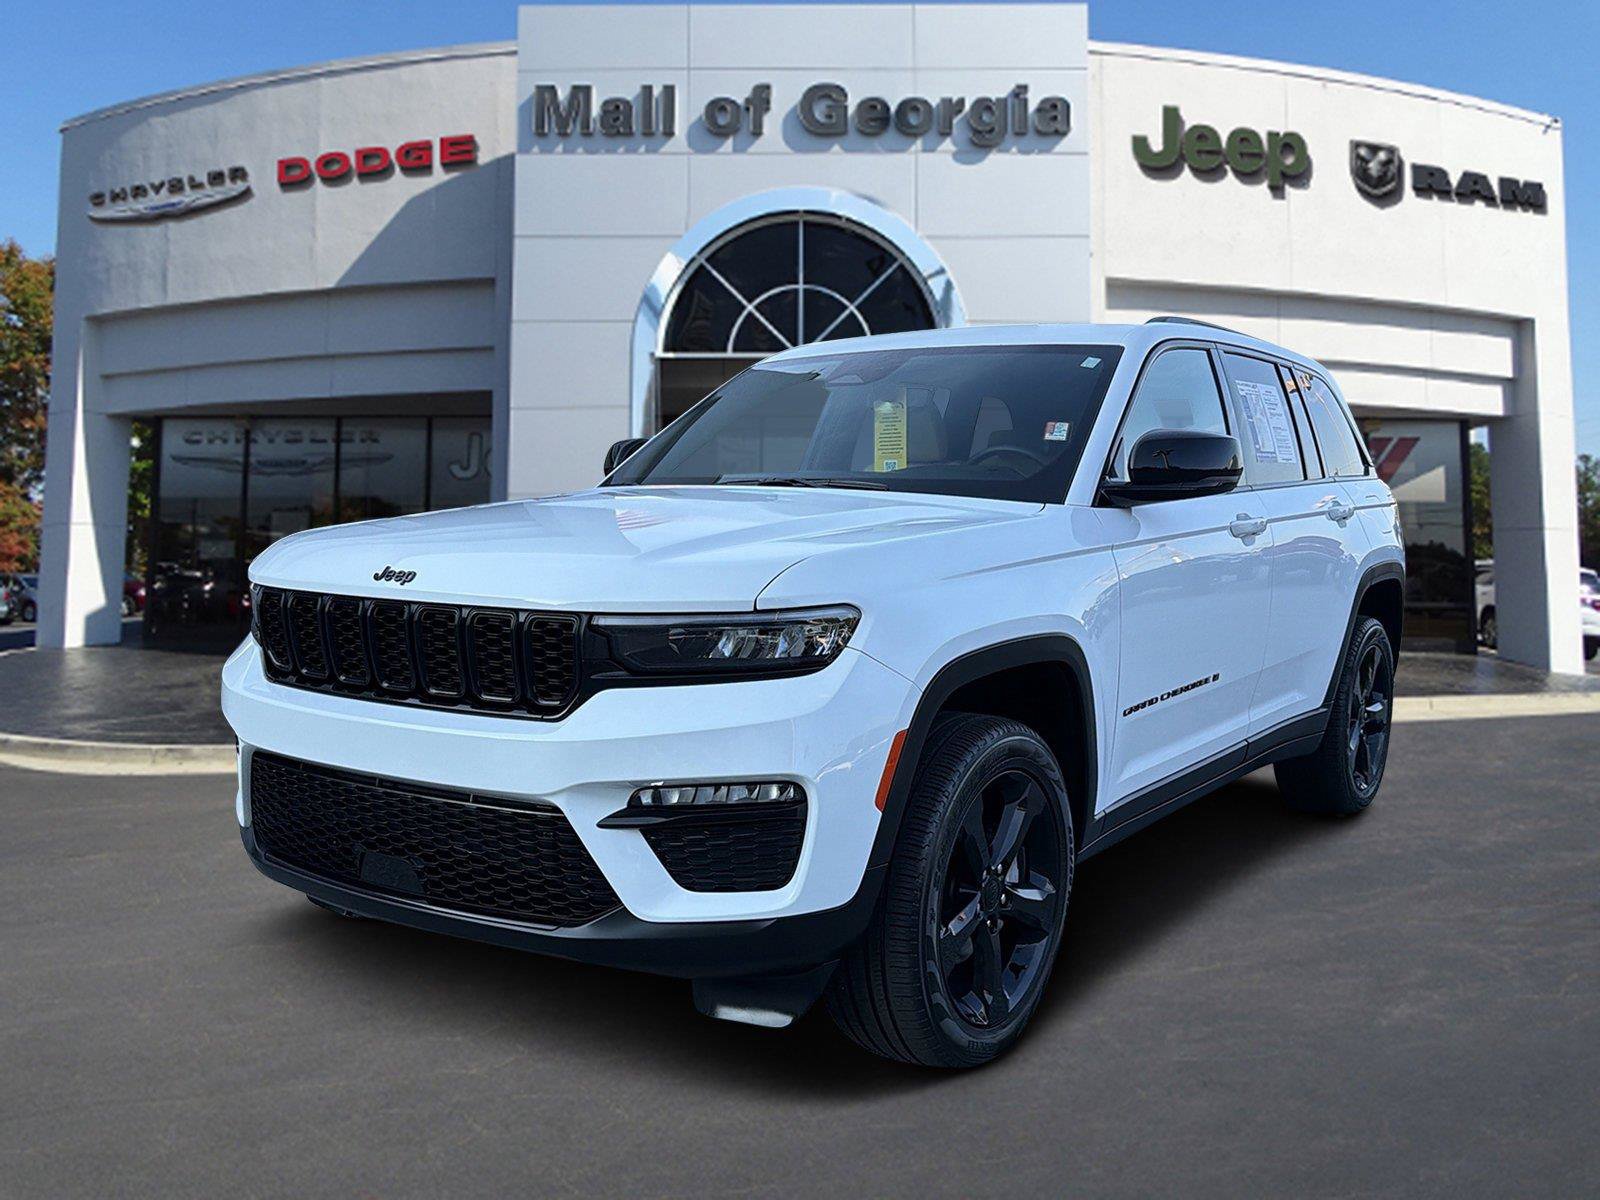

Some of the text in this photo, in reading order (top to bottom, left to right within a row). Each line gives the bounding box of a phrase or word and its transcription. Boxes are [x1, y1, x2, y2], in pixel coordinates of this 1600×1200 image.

[534, 83, 1071, 148] Mall of Georgia
[277, 134, 476, 186] DODGE
[1132, 105, 1308, 188] Jeep
[89, 166, 249, 207] CHRYSLER
[1411, 162, 1545, 210] RAM
[373, 565, 417, 586] Jeep
[1123, 675, 1212, 717] GRAND CHEROKEE
